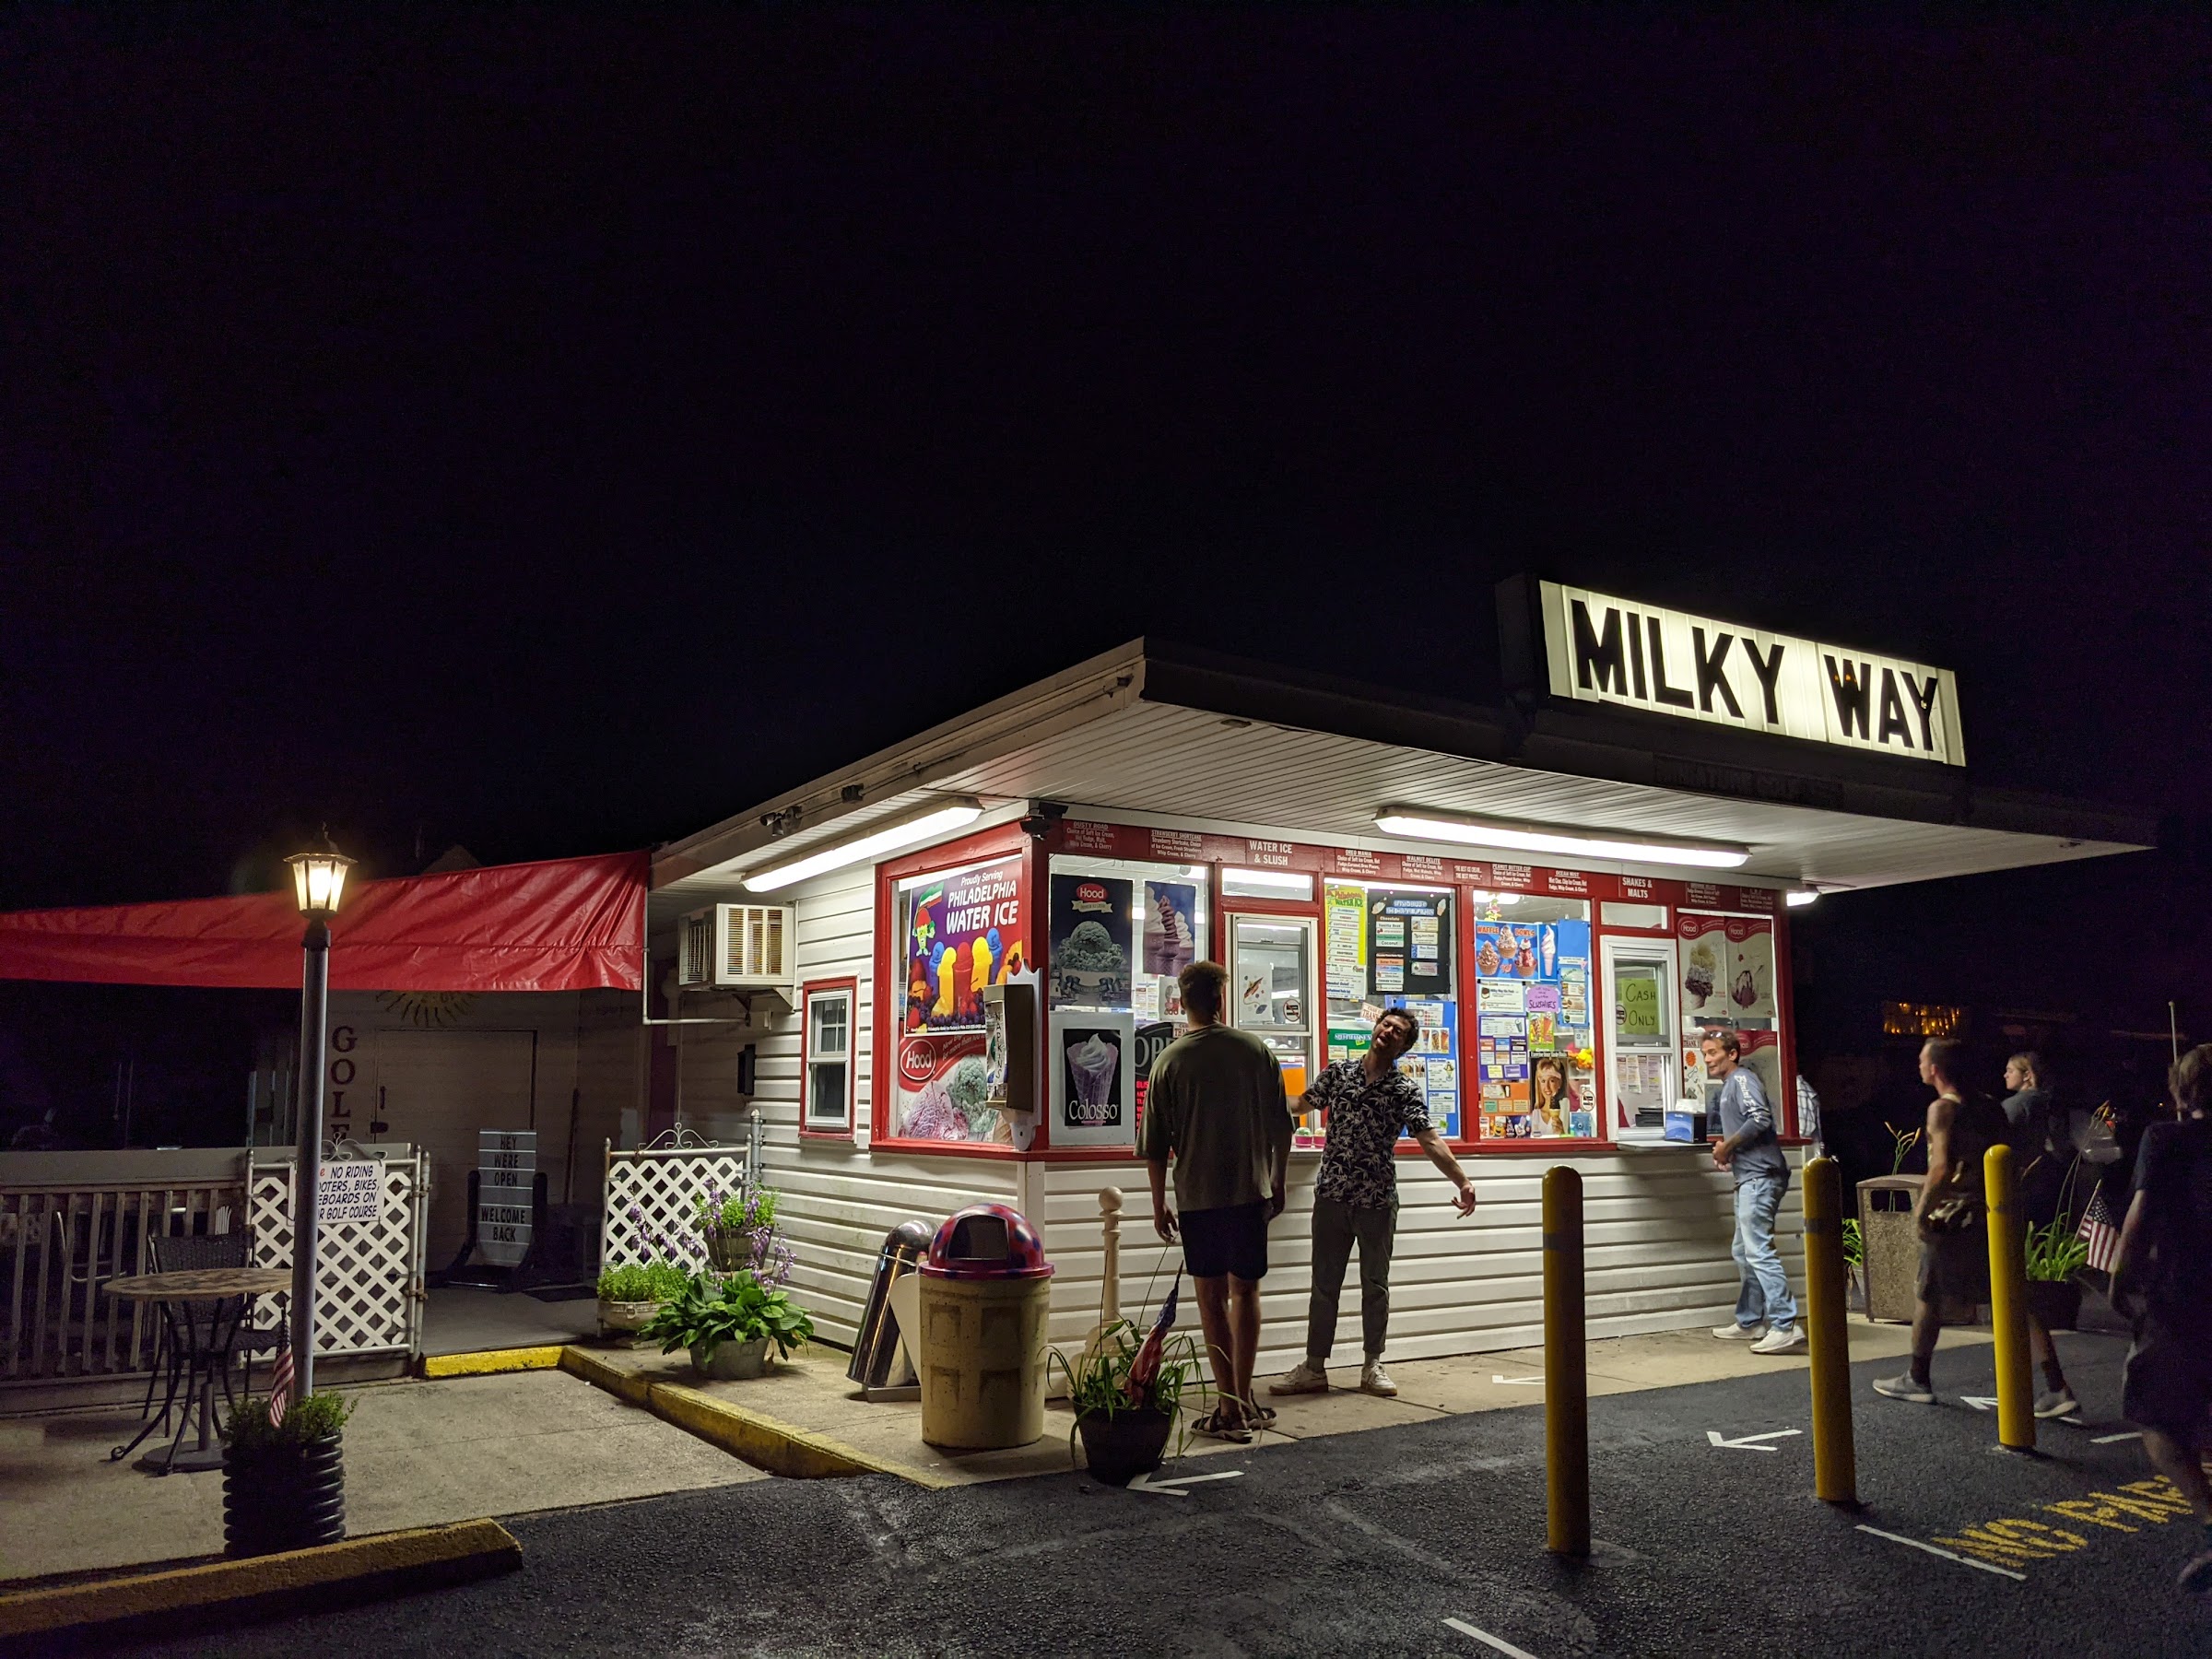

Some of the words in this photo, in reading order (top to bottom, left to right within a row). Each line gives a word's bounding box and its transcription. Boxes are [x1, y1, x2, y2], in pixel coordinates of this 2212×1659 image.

[1570, 598, 1785, 724] MILKY
[1823, 653, 1939, 752] WAY
[1152, 830, 1178, 838] STRAWBERRY
[1179, 832, 1202, 841] SHORTCAKE
[1249, 840, 1277, 852] WATER
[1279, 841, 1293, 853] ICE
[1254, 853, 1261, 864] &
[1263, 854, 1288, 866] SLUSH
[960, 873, 982, 887] Proudly
[982, 869, 1003, 883] Serving
[1622, 877, 1646, 888] SHAKES
[1647, 880, 1653, 888] &
[947, 879, 1017, 909] PHILADELPHIA
[1079, 887, 1104, 900] Hood
[1627, 888, 1649, 899] MALTS
[1335, 898, 1353, 906] WATER
[1354, 898, 1363, 907] ICE
[946, 908, 990, 934] WATER
[994, 900, 1019, 926] ICE
[1477, 925, 1500, 934] WAFFLE
[1514, 928, 1535, 936] BOWLS
[1683, 924, 1697, 933] Hood
[1730, 927, 1744, 935] Hood
[1625, 983, 1656, 1003] CASH
[1529, 999, 1557, 1009] SLUSHIES
[1629, 1010, 1656, 1026] ONLY
[994, 1011, 1004, 1079] NAPKINS
[906, 1051, 932, 1069] Hood
[331, 1025, 358, 1144] GOLF
[1069, 1098, 1117, 1121] Colosso
[500, 1135, 517, 1150] HEY
[494, 1154, 519, 1169] WERE
[330, 1166, 344, 1179] NO
[345, 1165, 373, 1179] RIDING
[494, 1172, 518, 1187] OPEN
[354, 1179, 380, 1192] BIKES,
[362, 1192, 377, 1203] ON
[326, 1206, 347, 1220] GOLF
[348, 1206, 378, 1218] COURSE
[481, 1207, 525, 1225] WELCOME
[493, 1227, 516, 1242] BACK
[1932, 1519, 2089, 1568] NO
